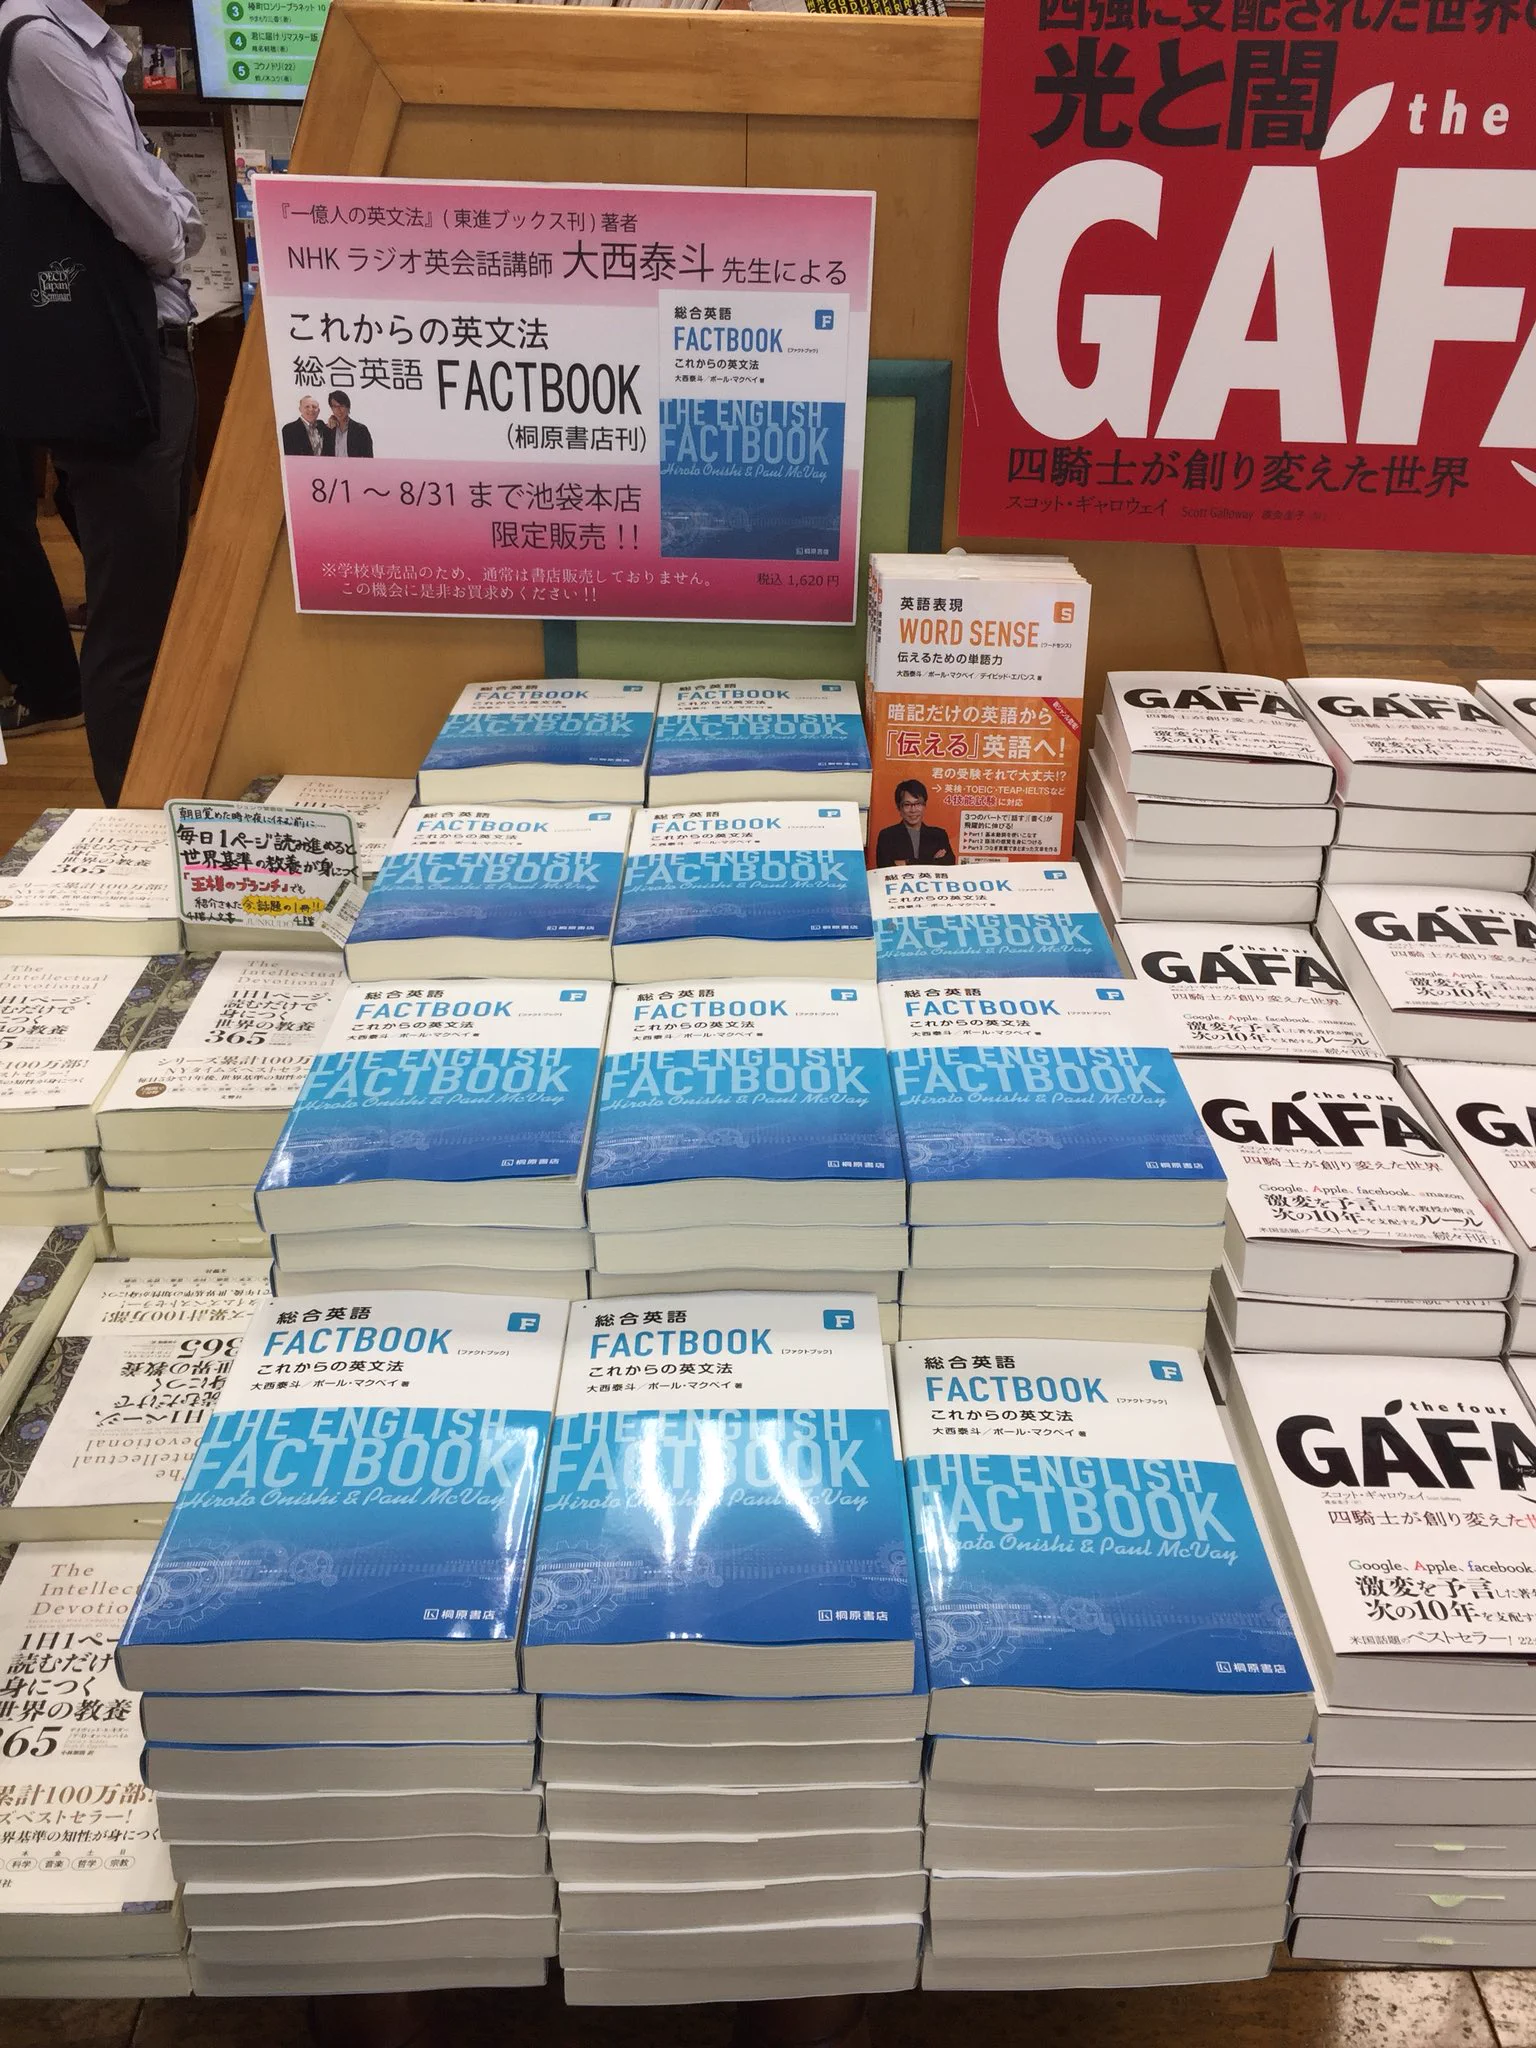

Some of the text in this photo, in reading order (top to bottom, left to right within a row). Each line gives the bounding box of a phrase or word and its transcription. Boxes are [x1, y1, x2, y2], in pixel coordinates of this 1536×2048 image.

[232, 6, 239, 17] 3
[235, 36, 242, 46] 4
[238, 66, 245, 76] 5
[1030, 36, 1339, 151] 光と闇
[1408, 90, 1509, 136] the
[281, 203, 434, 229] 『一億人の英文法』
[288, 241, 847, 286] NHK ラジオ英会話講師 大西泰斗 先生による
[999, 158, 1536, 448] GAF
[674, 306, 731, 320] 総合英語
[290, 312, 549, 350] これからの英文法
[674, 326, 783, 353] FACTBOOK
[675, 358, 759, 370] これからの英文法
[294, 356, 642, 415] 総合英語 FACTBOOK
[660, 399, 822, 428] THE ENGLISH
[660, 423, 829, 465] FACTBOOK
[703, 463, 741, 477] Onishi
[755, 464, 783, 478] Paul
[1008, 446, 1469, 499] 四騎士が創り変えた世界
[311, 478, 641, 513] 8/1 8/31 まで池袋本店
[900, 596, 963, 612] 英語表現
[900, 618, 1040, 648] WORD SENSE
[897, 651, 1003, 666] 伝えるための単語力
[475, 690, 589, 700] FACTBOOK
[677, 690, 791, 700] FACTBOOK
[888, 703, 1052, 725] 暗記だけの英語から
[1123, 688, 1306, 722] GAFA
[1317, 696, 1505, 729] GAFA
[656, 721, 849, 738] FACTBOOK
[416, 820, 549, 833] FACTBOOK
[651, 818, 782, 833] FACTBOOK
[51, 864, 108, 874] 365
[374, 862, 601, 886] FACTBOOK
[624, 862, 849, 887] FACTBOOK
[885, 880, 1013, 896] FACTBOOK
[888, 895, 988, 903] これからの英文法
[875, 924, 1092, 952] FACTBOOK
[241, 969, 343, 978] Intellectual
[1140, 950, 1350, 994] GAFA
[238, 977, 335, 986] Devotional
[904, 988, 982, 998] 総合英語
[355, 1001, 514, 1020] FACTBOOK
[633, 1000, 789, 1021] FACTBOOK
[905, 1000, 1062, 1017] FACTBOOK
[215, 1019, 317, 1032] 世界の教養
[351, 1021, 475, 1032] これからの英文法
[633, 1021, 756, 1032] これからの英文法
[910, 1019, 1031, 1028] これからの英文法
[204, 1030, 268, 1045] 365
[300, 1065, 573, 1101] FACTBOOK
[600, 1065, 871, 1100] FACTBOOK
[897, 1064, 1166, 1095] FACTBOOK
[1313, 1091, 1395, 1102] the four
[1201, 1098, 1444, 1150] GAFA
[1243, 1156, 1443, 1172] 四騎士が創り変えた世界
[276, 1306, 373, 1325] 総合英語
[594, 1310, 688, 1328] 総合英語
[263, 1327, 453, 1357] FACTBOOK
[590, 1328, 773, 1359] FACTBOOK
[257, 1360, 404, 1375] これからの英文法
[588, 1362, 733, 1378] これからの英文法
[924, 1355, 1016, 1370] 総合英語
[925, 1376, 1110, 1404] FACTBOOK
[931, 1409, 1074, 1423] これからの英文法
[1410, 1401, 1506, 1415] the four
[205, 1407, 508, 1443] THE ENGLISH
[72, 1452, 194, 1468] ntellectual
[182, 1436, 515, 1492] FACTBOOK
[910, 1454, 1202, 1494] THE ENGLISH
[363, 1489, 417, 1506] Paul
[914, 1483, 1237, 1544] FACTBOOK
[1100, 1537, 1152, 1557] Paul
[51, 1563, 95, 1578] The
[441, 1608, 496, 1621] 桐原書店
[835, 1609, 889, 1622] 桐原書店
[1364, 1600, 1536, 1622] 次の10年を支配す
[6, 1652, 114, 1674] 読むだけ
[1233, 1662, 1287, 1674] 桐原書店
[0, 1676, 96, 1698] 身につく
[0, 1726, 63, 1758] 65
[0, 1828, 160, 1844] 界基準の知性が身につく
